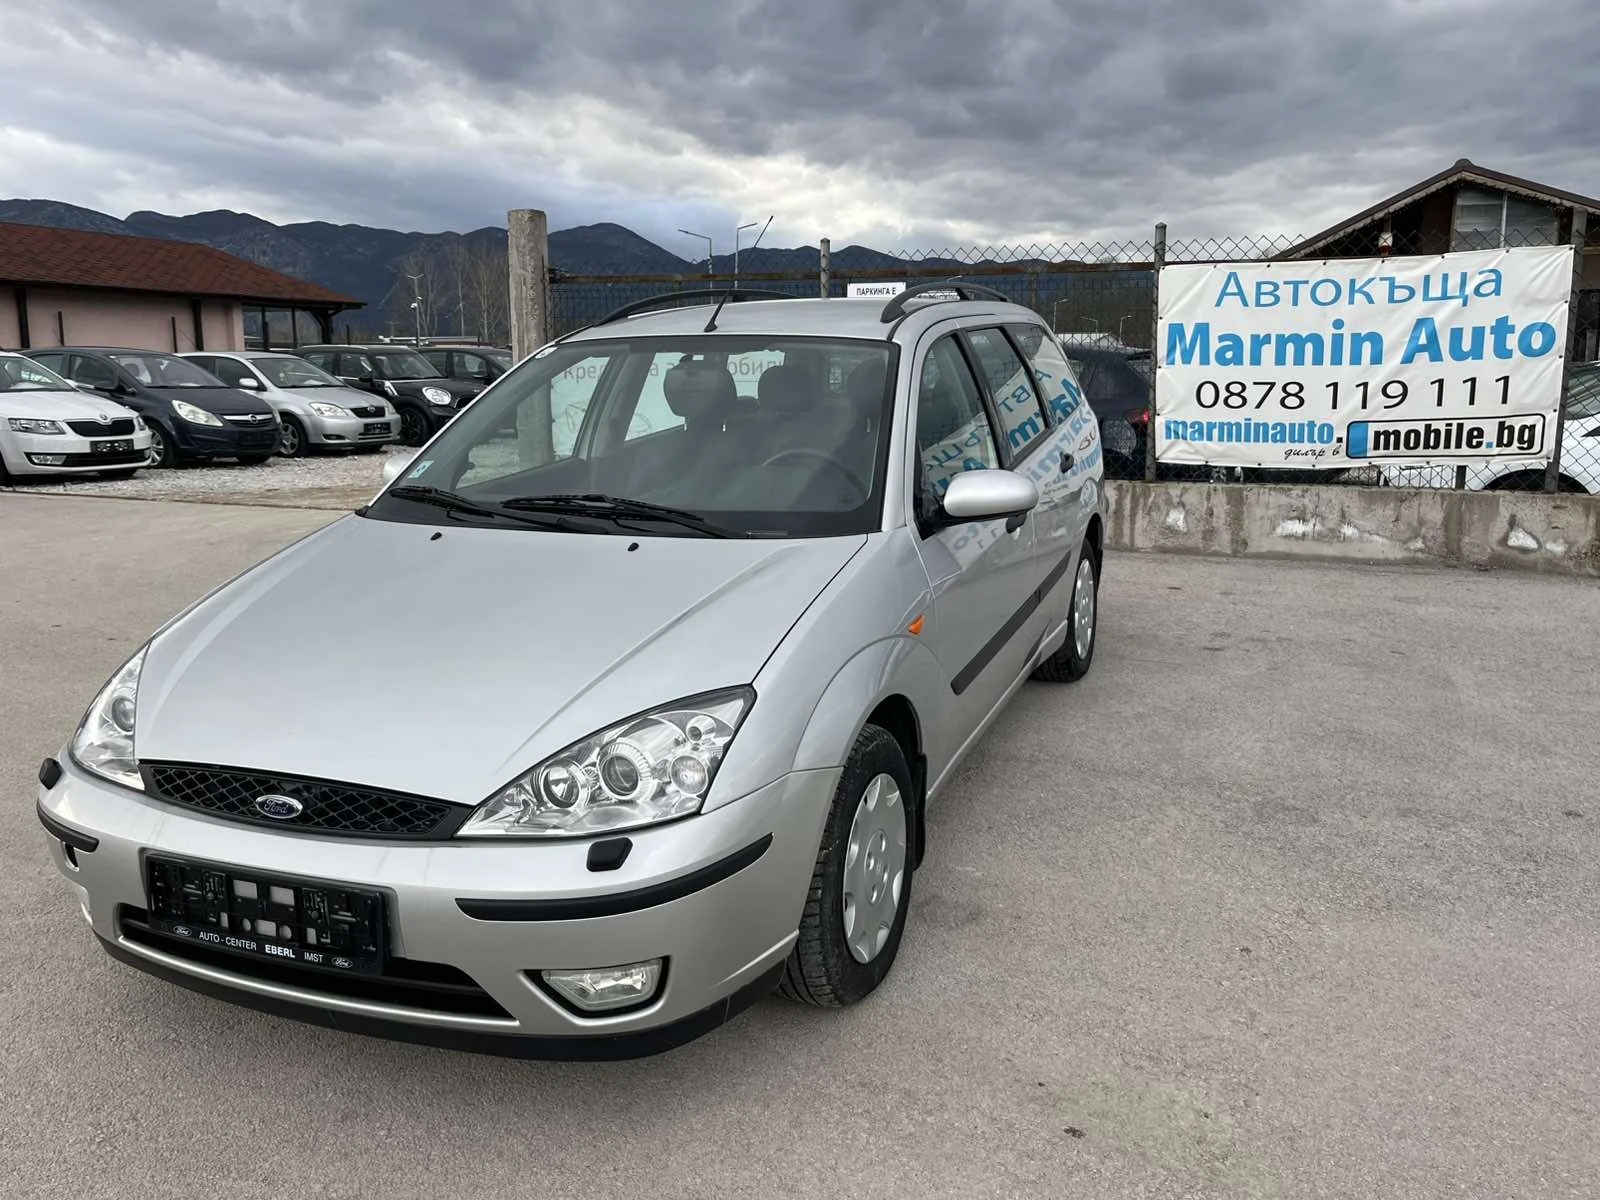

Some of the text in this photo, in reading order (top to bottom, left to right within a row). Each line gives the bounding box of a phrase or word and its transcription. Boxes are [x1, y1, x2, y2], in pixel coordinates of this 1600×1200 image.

[1215, 268, 1503, 309] Автокъща
[1165, 315, 1557, 368] Marmin Auto
[1195, 375, 1511, 410] 0878 119 111
[1373, 420, 1537, 452] mobile.bg
[199, 931, 220, 943] AUTO
[225, 936, 257, 951] CENTER
[265, 944, 296, 958] EBERL
[304, 951, 324, 963] IMST
